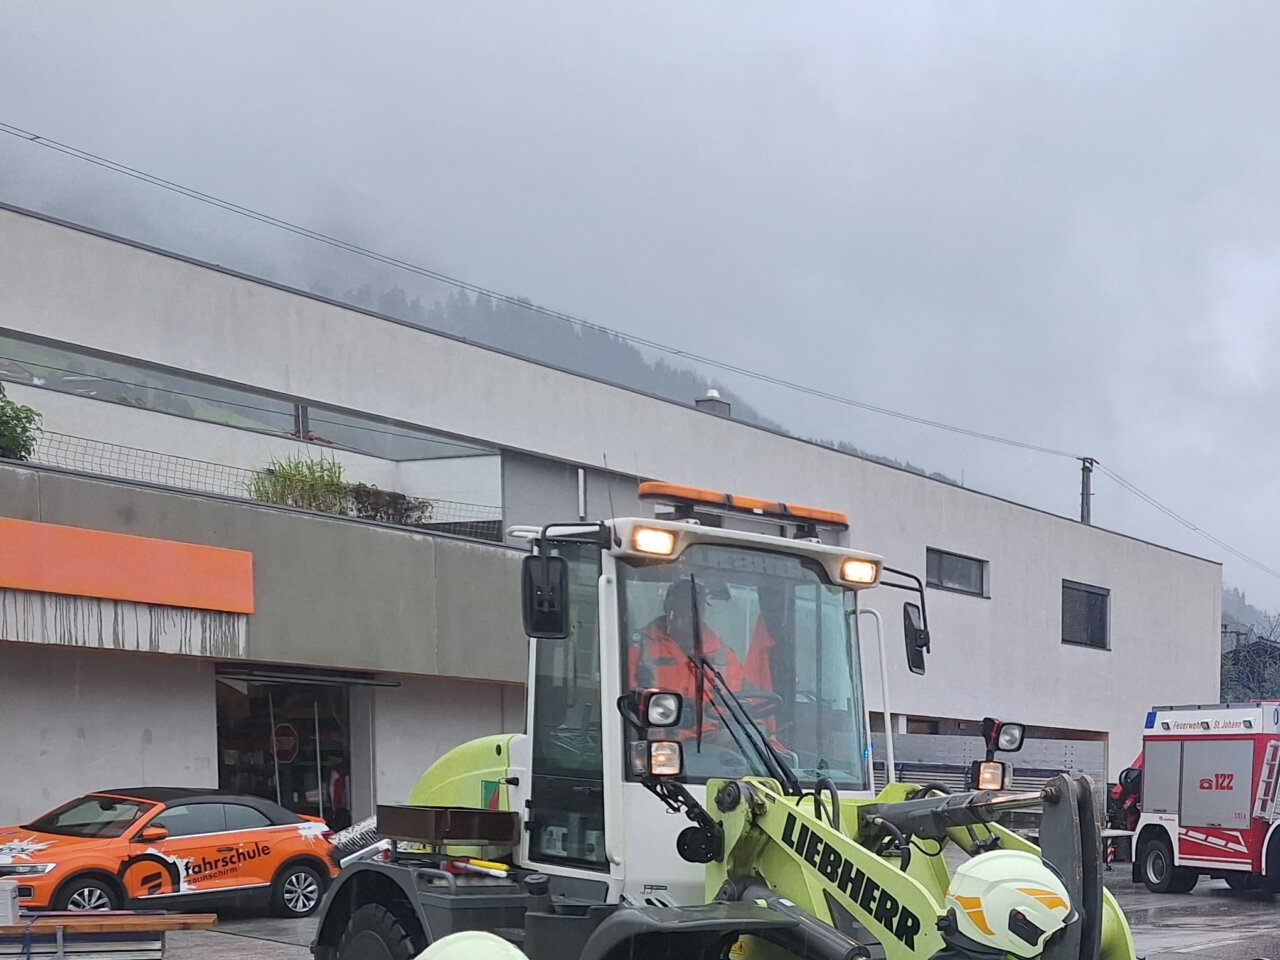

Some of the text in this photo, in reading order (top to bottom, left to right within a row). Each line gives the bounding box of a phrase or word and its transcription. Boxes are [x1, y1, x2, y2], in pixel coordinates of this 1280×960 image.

[1215, 774, 1233, 790] 122
[184, 842, 271, 877] fahrschule
[781, 811, 921, 952] LIEBHERR
